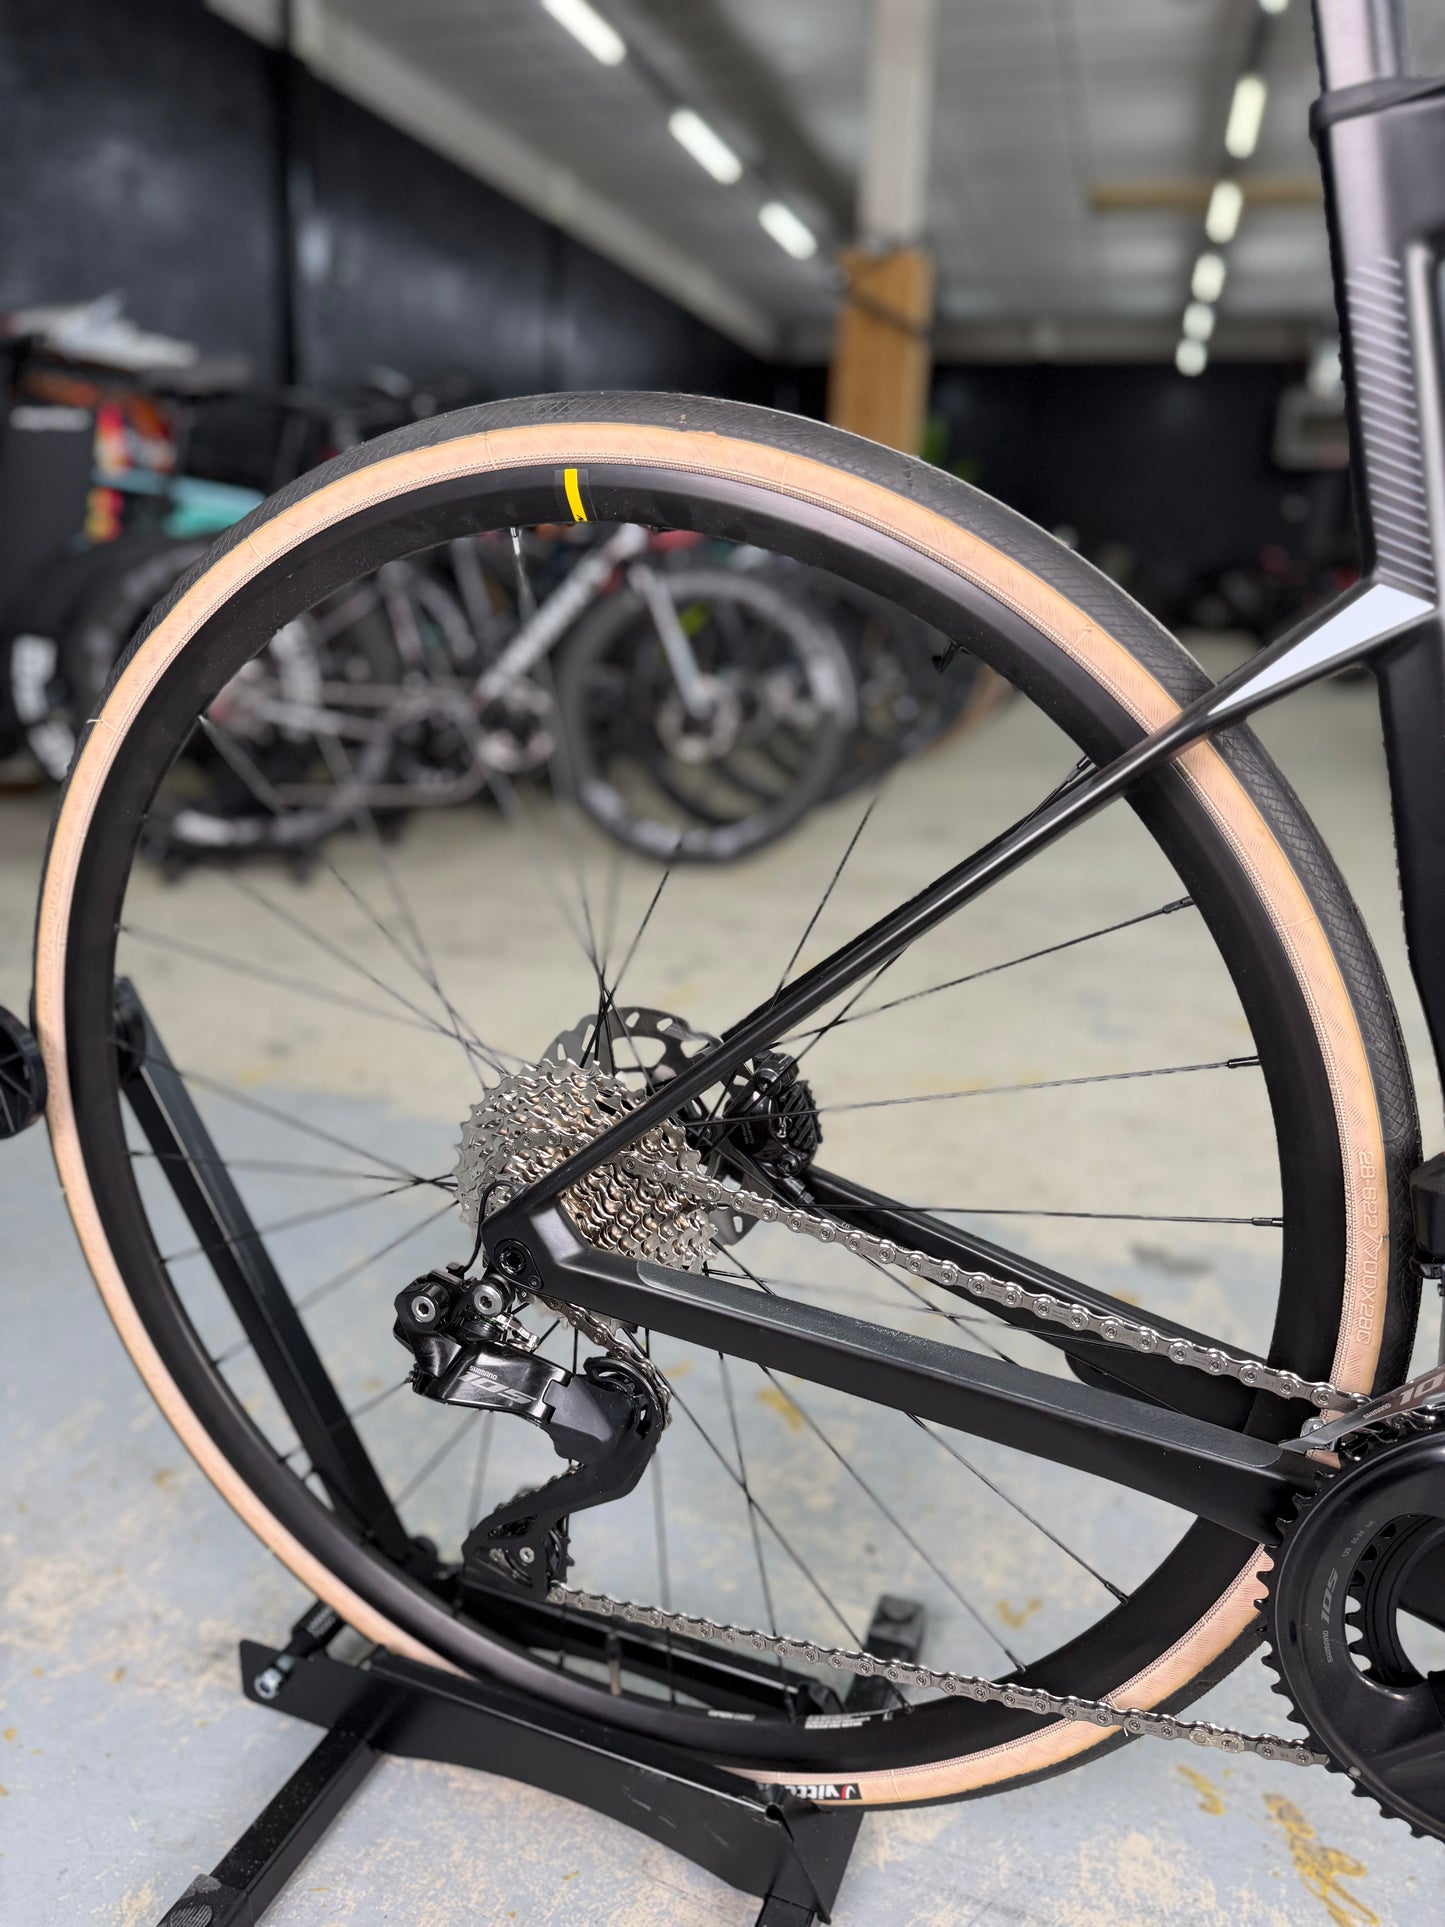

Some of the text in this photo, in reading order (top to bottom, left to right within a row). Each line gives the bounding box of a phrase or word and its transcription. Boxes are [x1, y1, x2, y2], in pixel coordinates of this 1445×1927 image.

[1359, 1151, 1378, 1228] 28-622
[458, 1371, 538, 1404] 105
[469, 1365, 498, 1380] SHIMANO
[1362, 1371, 1445, 1419] SHIMANO 10
[1321, 1568, 1339, 1624] 105
[1322, 1630, 1334, 1664] SHIMANO
